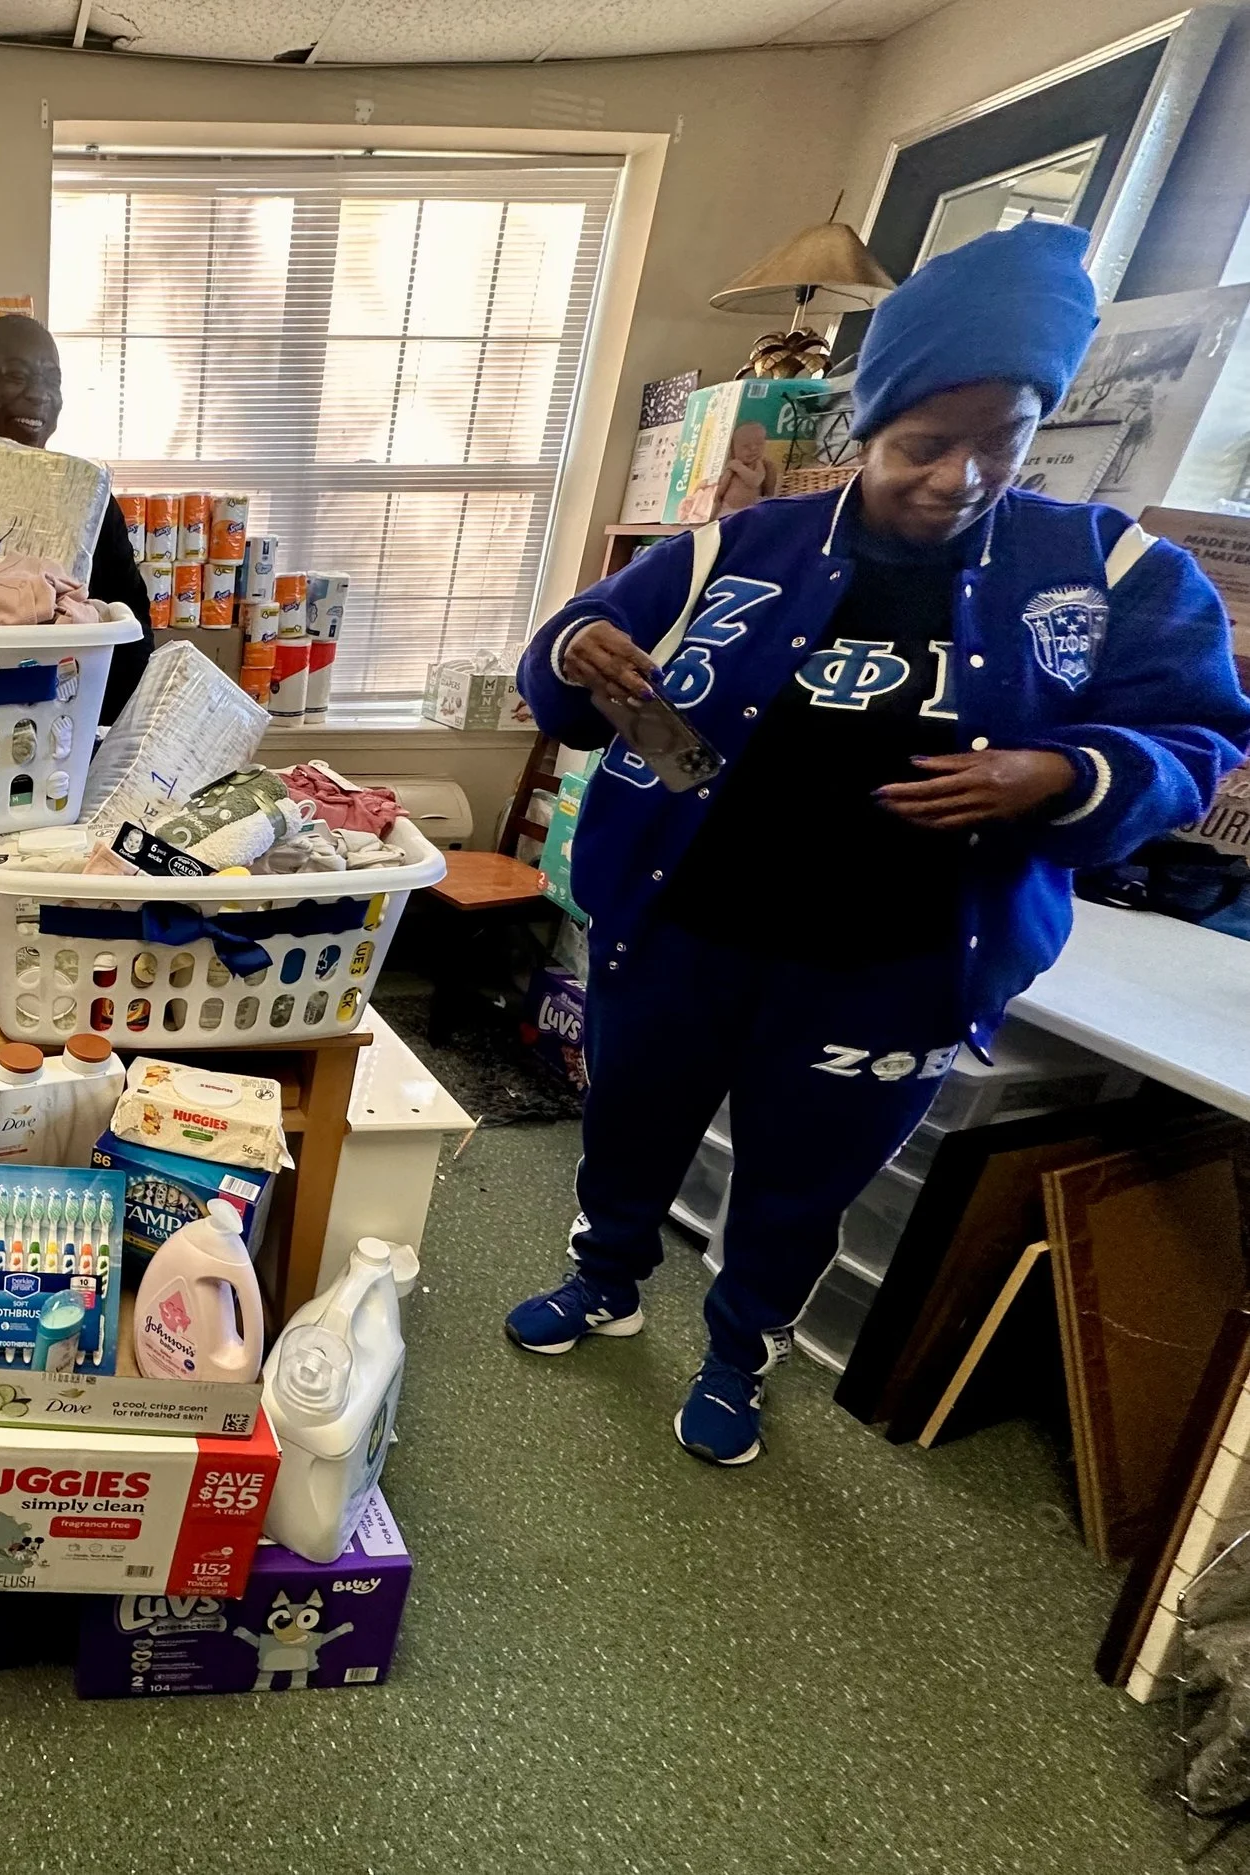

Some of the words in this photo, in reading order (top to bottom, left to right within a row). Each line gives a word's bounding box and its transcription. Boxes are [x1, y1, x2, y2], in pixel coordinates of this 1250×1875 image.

[676, 423, 701, 493] Pampers
[1046, 454, 1075, 465] with
[1183, 534, 1230, 549] MADE
[440, 679, 461, 691] DIAPERS
[150, 844, 158, 853] 6
[173, 861, 188, 873] STAY
[2, 1116, 36, 1133] Dove
[173, 1109, 229, 1131] HUGGIES
[241, 1144, 253, 1155] 56
[92, 1151, 112, 1168] 86
[144, 1315, 196, 1358] Johnson's
[159, 1339, 176, 1354] baby
[45, 1398, 92, 1415] Dove
[122, 1401, 148, 1410] cool,
[149, 1402, 176, 1413] crisp
[178, 1404, 208, 1413] scent
[112, 1408, 127, 1417] for
[129, 1410, 181, 1421] refreshed
[183, 1413, 204, 1422] skin
[204, 1471, 265, 1487] SAVE
[198, 1486, 261, 1510] $55
[21, 1498, 88, 1514] simply
[93, 1499, 145, 1514] clean
[61, 1519, 109, 1529] fragrance
[110, 1520, 131, 1529] free
[373, 1508, 386, 1527] EASY
[382, 1528, 393, 1545] FOR
[191, 1563, 231, 1576] 1152
[156, 1623, 221, 1633] protection
[131, 1676, 144, 1687] 2
[150, 1684, 170, 1692] 104
